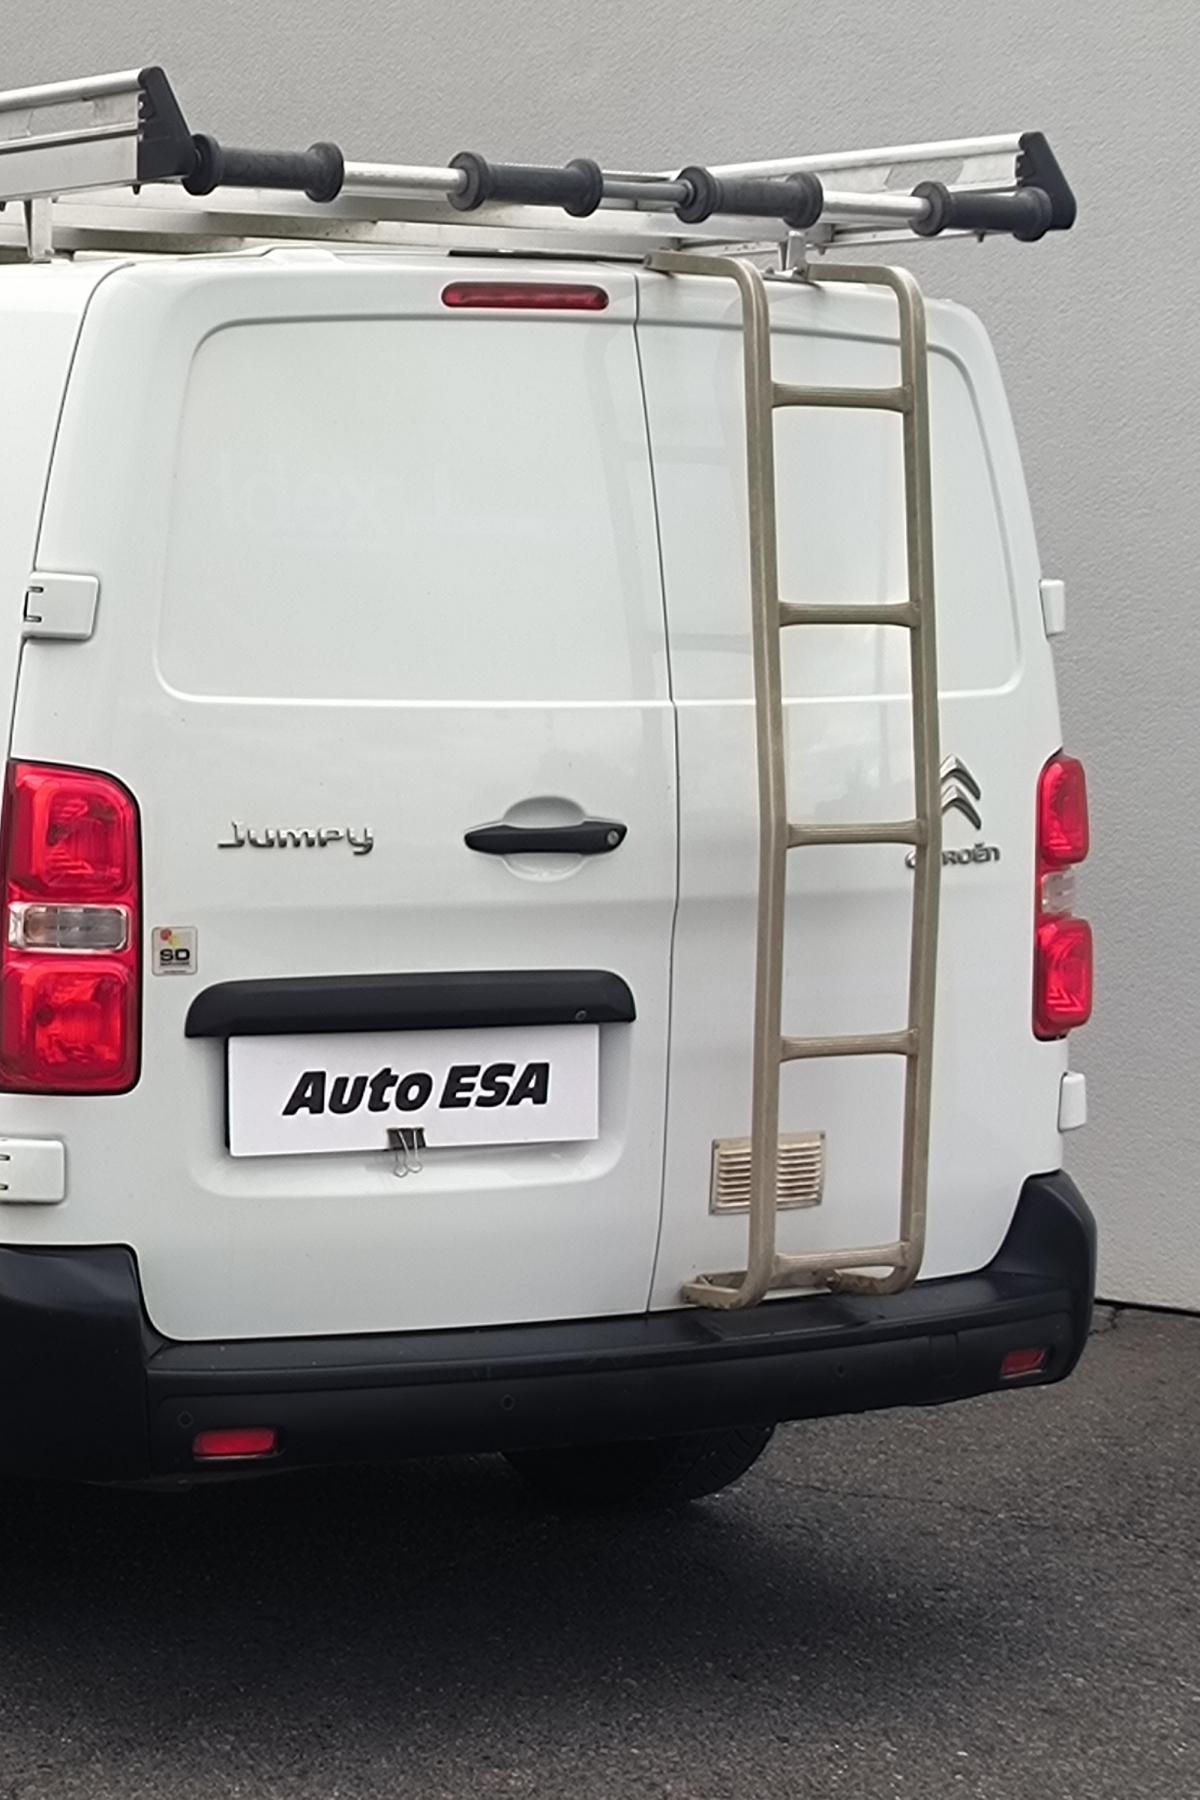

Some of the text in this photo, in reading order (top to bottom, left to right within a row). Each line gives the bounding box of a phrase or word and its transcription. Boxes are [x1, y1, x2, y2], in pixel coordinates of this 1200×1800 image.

[217, 820, 374, 856] Jumpy
[282, 1062, 550, 1116] Auto ESA
